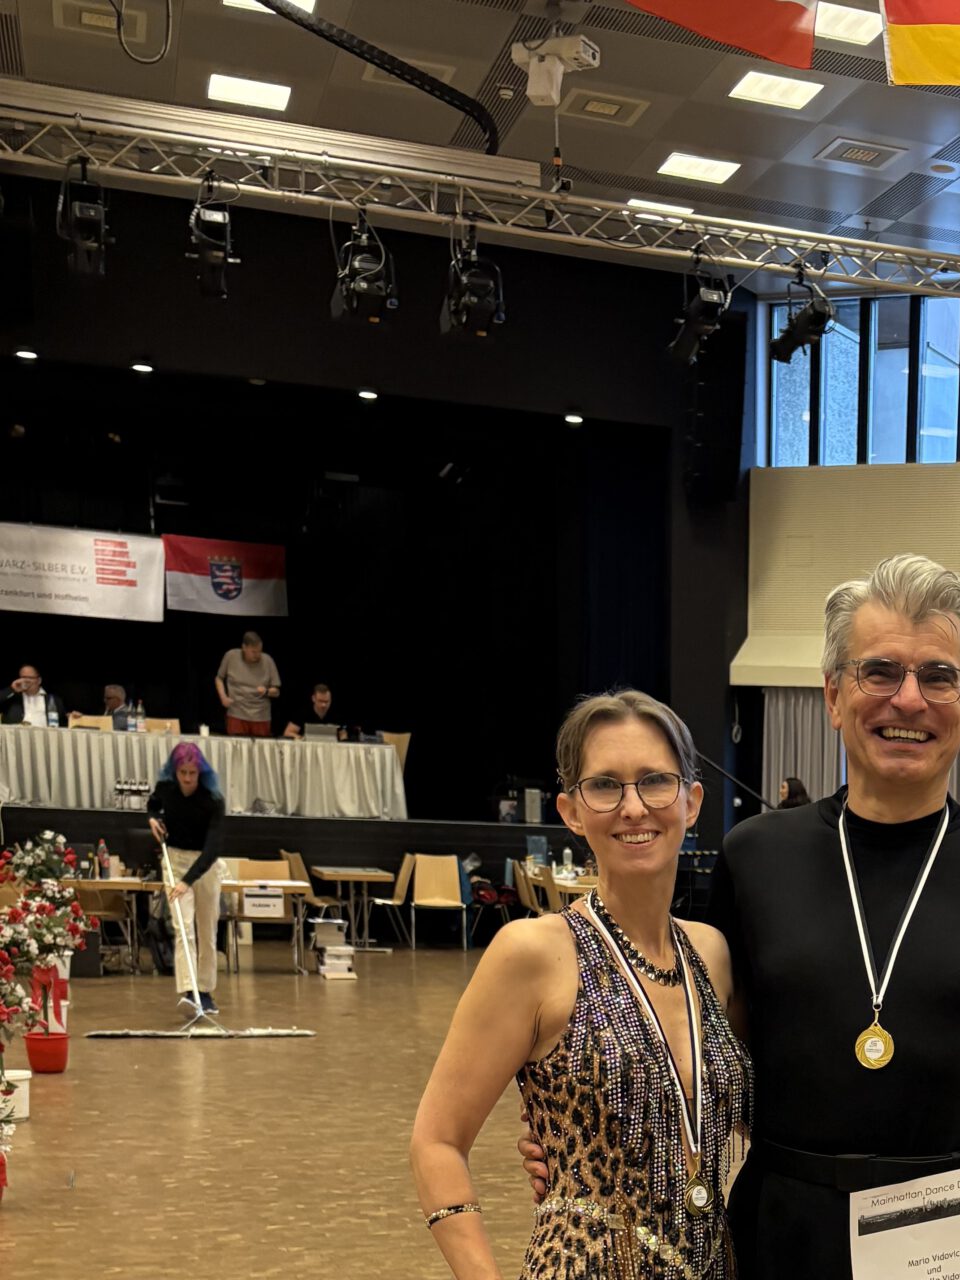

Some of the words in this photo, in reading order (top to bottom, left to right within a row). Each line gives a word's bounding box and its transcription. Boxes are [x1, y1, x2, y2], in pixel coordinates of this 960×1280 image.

[871, 1189, 923, 1208] Mainhattan
[925, 1183, 955, 1197] Dance
[908, 1257, 930, 1268] Mario
[931, 1250, 960, 1262] Vidovic
[927, 1265, 942, 1275] und
